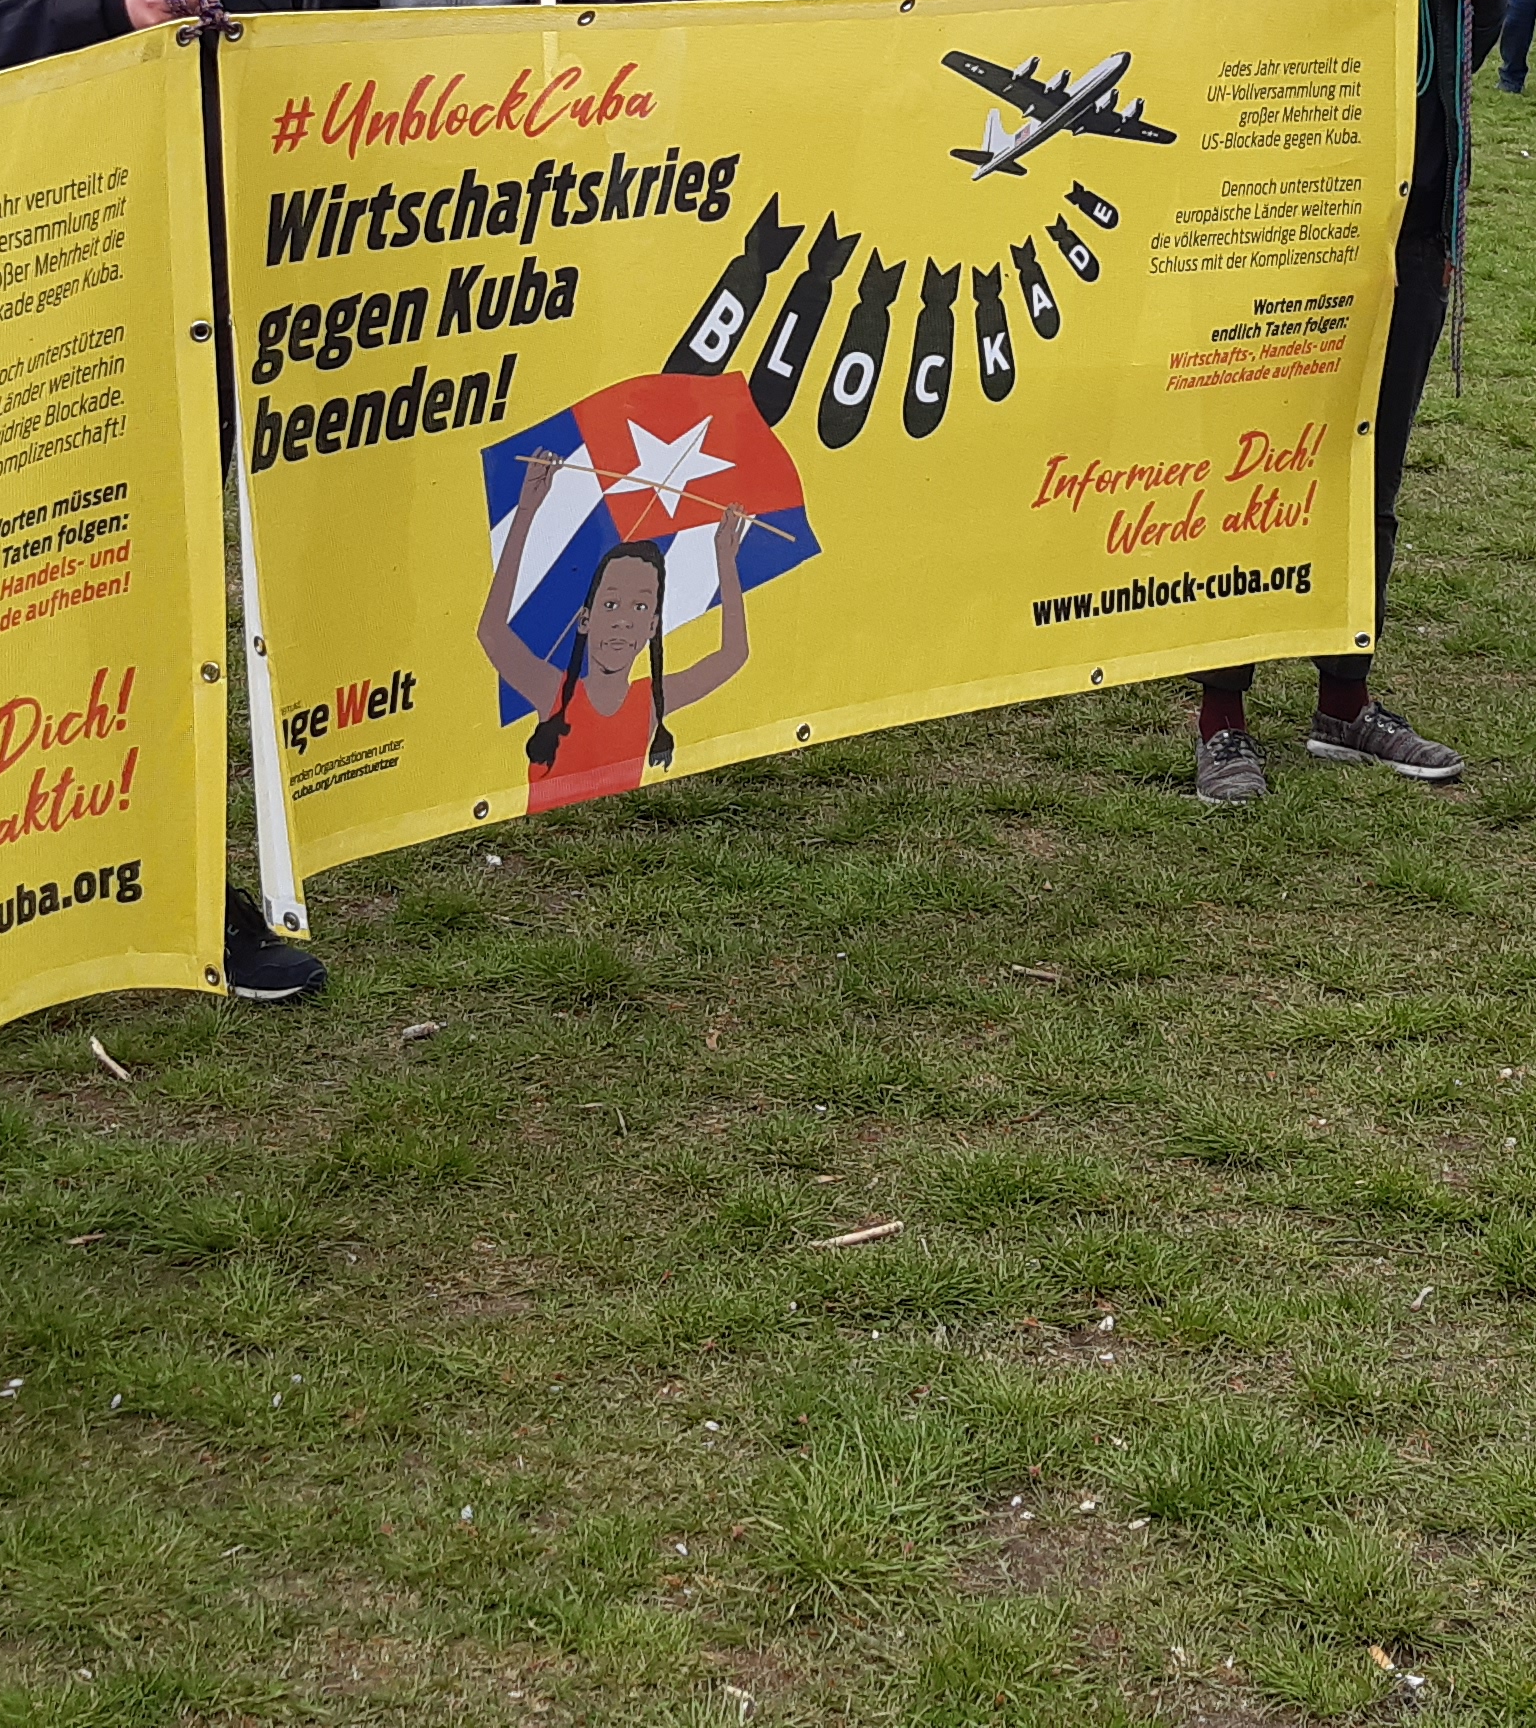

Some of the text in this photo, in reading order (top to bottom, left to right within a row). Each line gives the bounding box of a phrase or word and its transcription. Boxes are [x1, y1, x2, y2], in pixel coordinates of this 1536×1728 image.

[1218, 57, 1361, 78] Jedes Jahr verurteilt die
[271, 62, 658, 160] #UnblockCuba
[1207, 81, 1361, 102] UN-Vollversammlung mit
[1238, 104, 1362, 128] großer Mehrheit die
[1201, 128, 1361, 150] US-Blockade gegen Kuba.
[25, 172, 103, 211] verurteilt
[107, 167, 129, 191] die
[266, 147, 742, 267] Wirtschaftskrieg
[1221, 176, 1362, 197] Dennoch unterstützen
[102, 196, 127, 223] mit
[1175, 199, 1363, 225] europäische Länder weiterhin
[35, 241, 100, 277] Mehrheit
[102, 230, 125, 254] die
[1150, 223, 1361, 249] die völkerrechtswidrige Blockade.
[1149, 245, 1360, 274] Schluss mit der Komplizenschaft!
[35, 278, 80, 313] gegen
[82, 262, 124, 292] Kuba.
[689, 201, 1114, 407] BLOCKADE
[1254, 294, 1355, 315] Worten müssen
[252, 255, 580, 385] gegen Kuba
[1211, 315, 1350, 342] endlich Taten folgen:
[27, 324, 125, 374] unterstützen
[1169, 335, 1346, 369] Wirtschafts-, Handels- und
[48, 355, 125, 396] weiterhin
[1166, 357, 1341, 391] Finanzblockade aufheben!
[44, 386, 125, 428] Blockade.
[251, 353, 518, 476] beenden!
[1031, 422, 1328, 513] Informiere Dich!
[51, 481, 128, 520] müssen
[1106, 479, 1318, 555] Werde aktiv!
[2, 533, 52, 569] Taten
[57, 512, 130, 553] folgen:
[0, 557, 85, 601] Handels-
[89, 539, 131, 569] und
[25, 571, 131, 620] aufheben!
[1033, 562, 1312, 627] www.unblock-cuba.org
[336, 669, 417, 729] Welt
